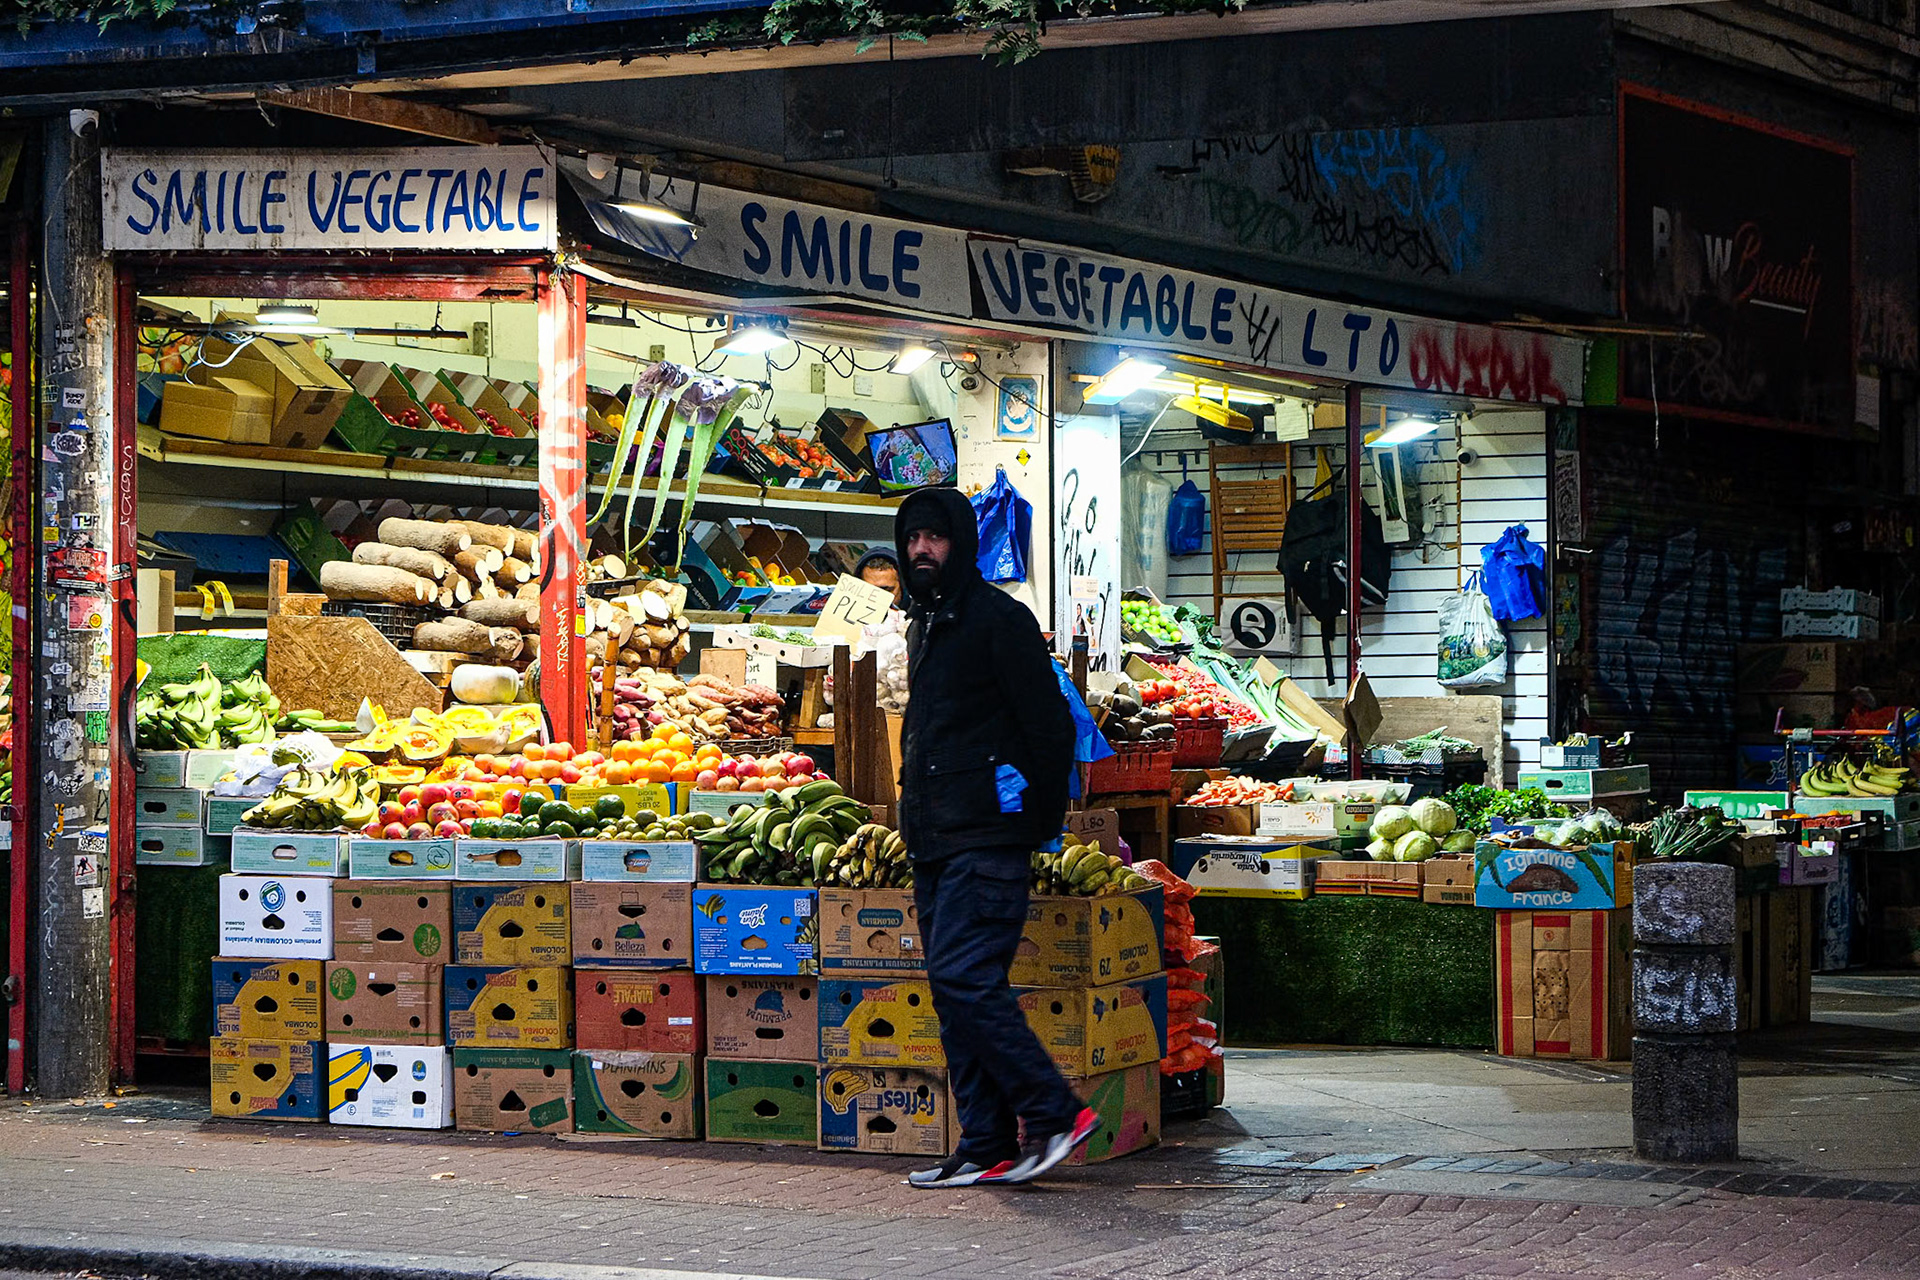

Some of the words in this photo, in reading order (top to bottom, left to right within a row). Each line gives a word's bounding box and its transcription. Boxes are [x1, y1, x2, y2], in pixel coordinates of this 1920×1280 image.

[126, 168, 287, 235] SMILE
[307, 167, 544, 234] VEGETABLE
[1733, 219, 1823, 343] Beauty
[740, 201, 924, 299] SMILE
[982, 246, 1236, 346] VEGETABLE
[1301, 307, 1400, 377] LTD
[833, 595, 876, 626] PLZ
[1503, 851, 1577, 873] Igname
[1512, 890, 1574, 906] France
[861, 917, 900, 926] COLOMBIAN
[224, 936, 253, 944] plantains
[254, 937, 293, 945] COLOMBIAN
[294, 937, 322, 946] premium
[530, 946, 567, 954] COLOMBA
[614, 940, 646, 951] Belleza
[460, 951, 473, 960] LBS
[473, 951, 483, 960] 50
[1119, 943, 1149, 961] COLOMBA
[729, 961, 758, 969] PLANTAINS
[758, 961, 782, 969] PREMIUM
[841, 959, 883, 968] PLANTAINS
[885, 960, 922, 969] PREMIUM
[1099, 957, 1111, 977] 79
[741, 981, 794, 991] PLANTAINS
[746, 1008, 793, 1024] PREMIUM
[218, 1023, 231, 1032] LBS
[232, 1023, 240, 1032] 50
[284, 1020, 318, 1029] COLOMBA
[451, 1030, 465, 1039] LBS
[523, 1027, 560, 1036] COLOMBA
[299, 1045, 311, 1055] LBS
[823, 1048, 838, 1057] LBS
[839, 1048, 849, 1057] 50
[508, 1056, 540, 1066] Premium
[1092, 1047, 1106, 1067] 79
[822, 1134, 857, 1145] Bananas
